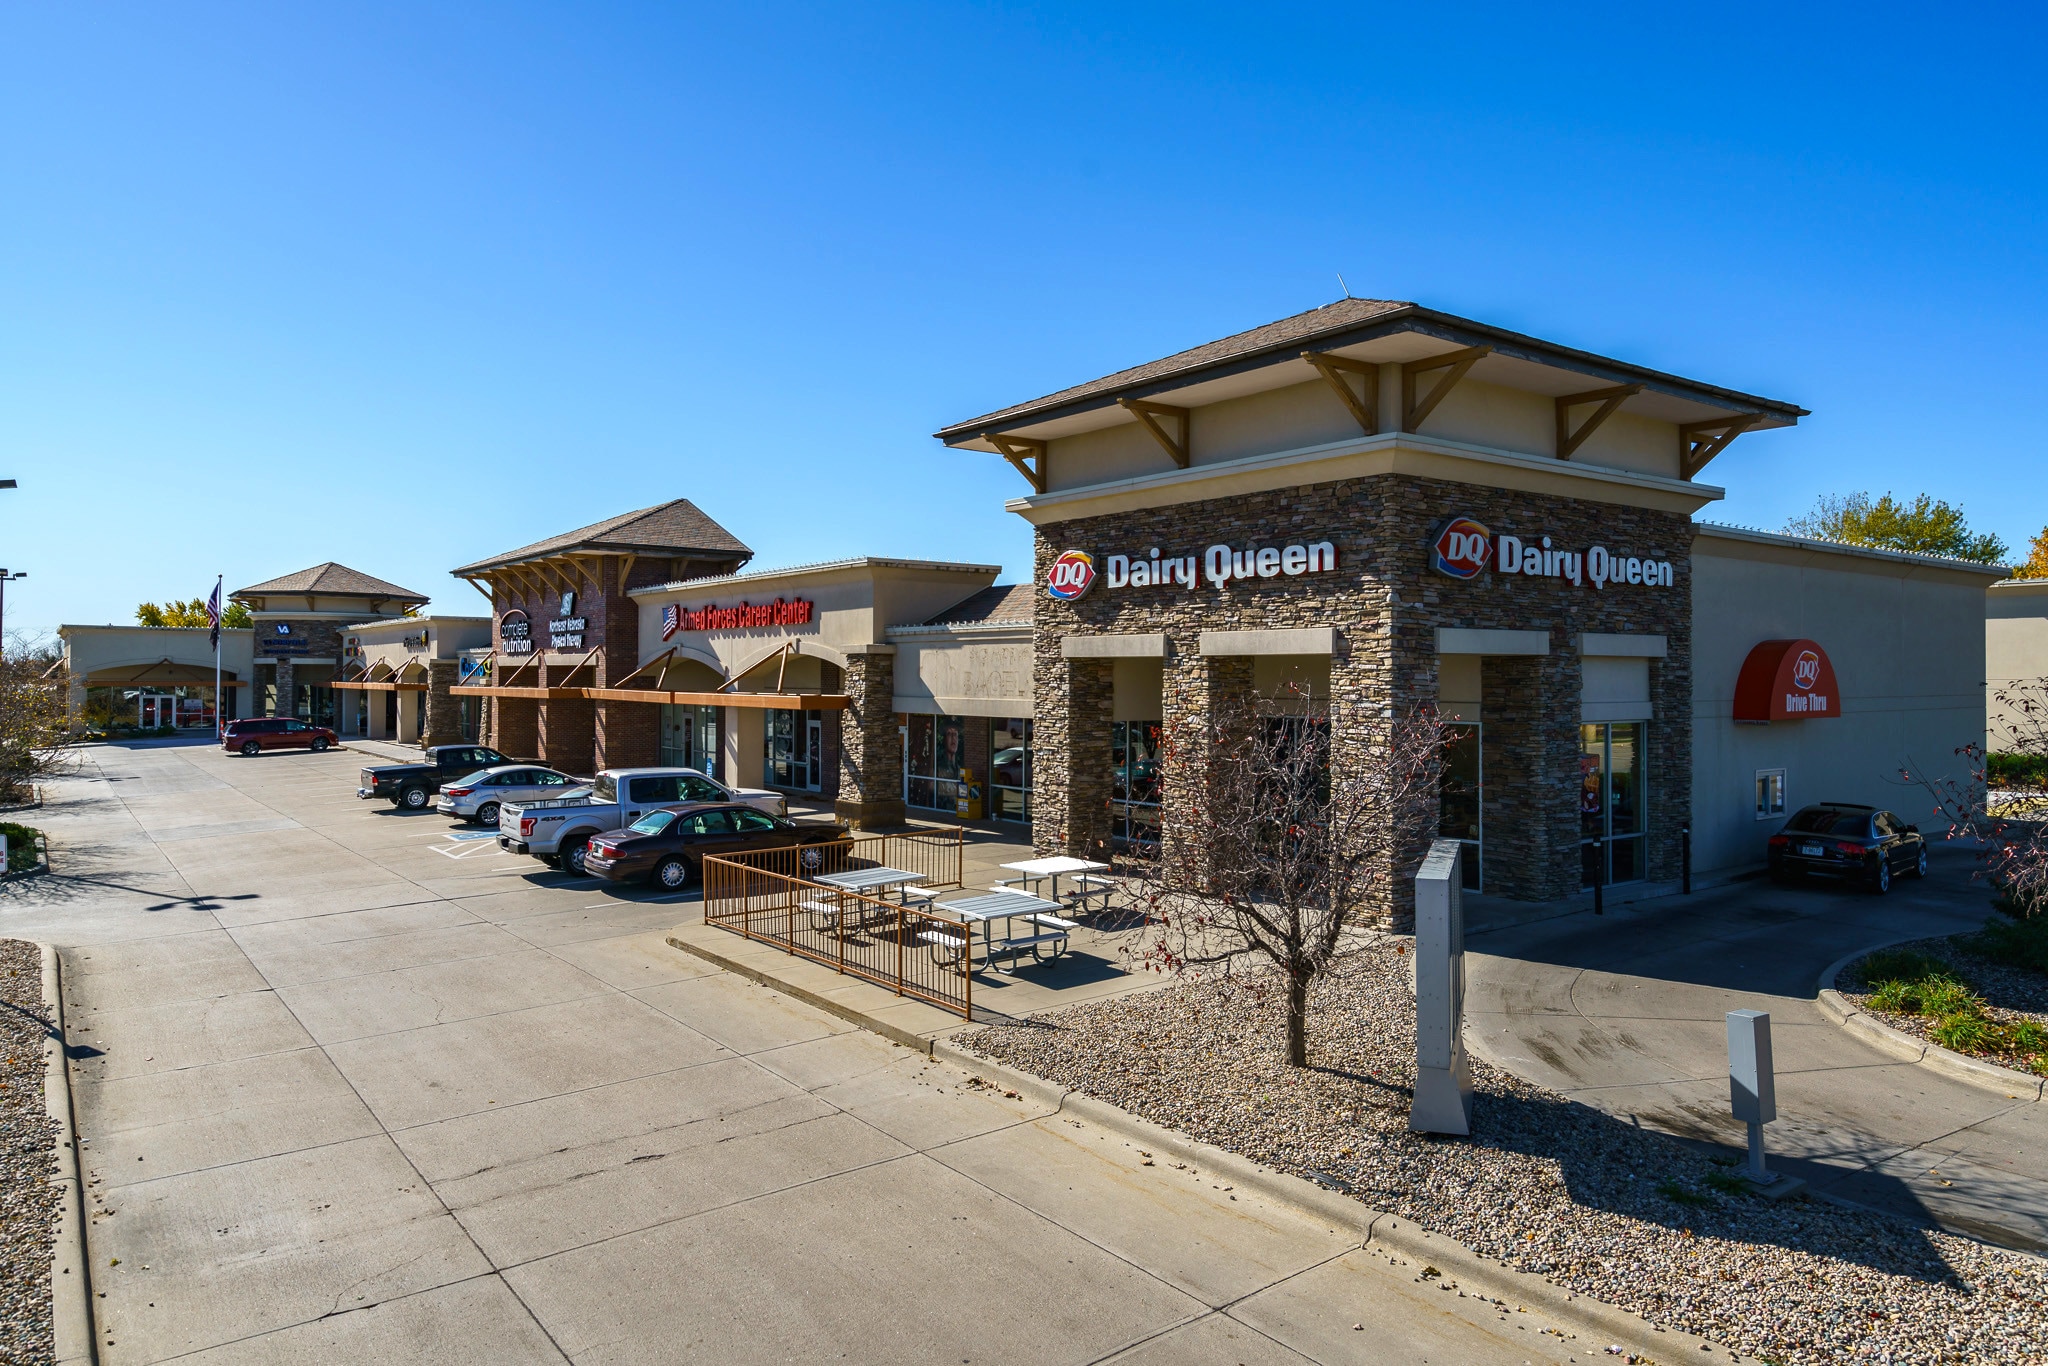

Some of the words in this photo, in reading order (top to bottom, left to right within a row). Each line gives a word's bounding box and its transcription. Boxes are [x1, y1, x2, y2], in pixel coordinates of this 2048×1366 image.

[1448, 532, 1484, 565] DQ
[1054, 561, 1088, 588] DQ
[1107, 547, 1196, 590] Dairy
[1205, 541, 1335, 590] Queen
[1499, 535, 1582, 587] Dairy
[1588, 545, 1673, 590] Queen
[680, 605, 706, 631] Armed
[707, 605, 737, 630] Forces
[739, 602, 771, 628] Career
[773, 599, 811, 626] Center
[277, 625, 290, 634] VA
[501, 620, 528, 637] complete
[502, 636, 532, 653] nutrition
[1798, 660, 1815, 681] DQ
[1786, 693, 1808, 712] Drive
[1808, 693, 1827, 712] Thru
